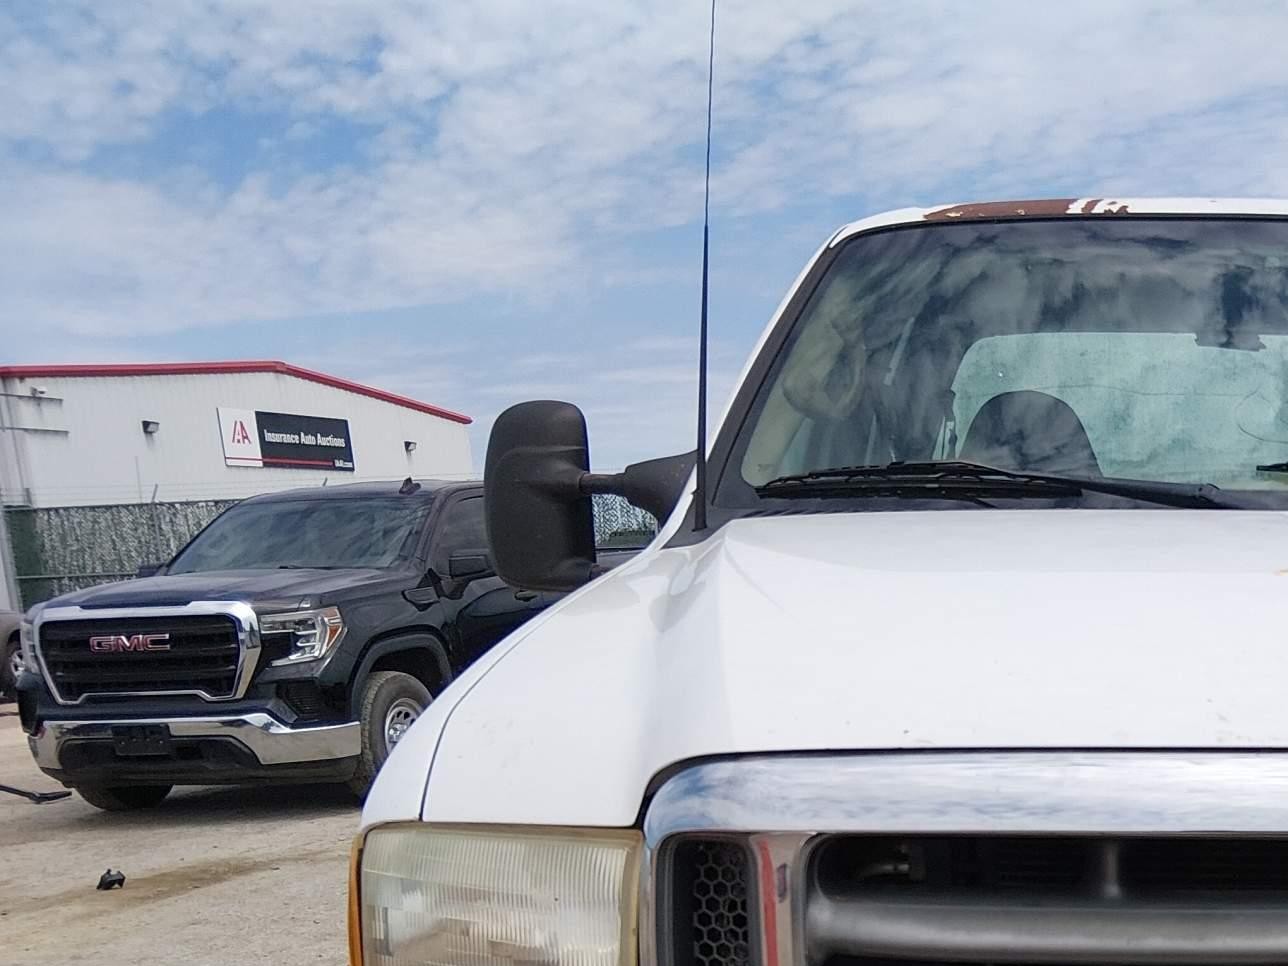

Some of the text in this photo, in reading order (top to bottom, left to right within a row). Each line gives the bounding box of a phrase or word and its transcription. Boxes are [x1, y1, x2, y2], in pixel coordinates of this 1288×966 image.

[263, 429, 346, 448] Insurance Auto Auctions
[89, 633, 170, 653] GMC
